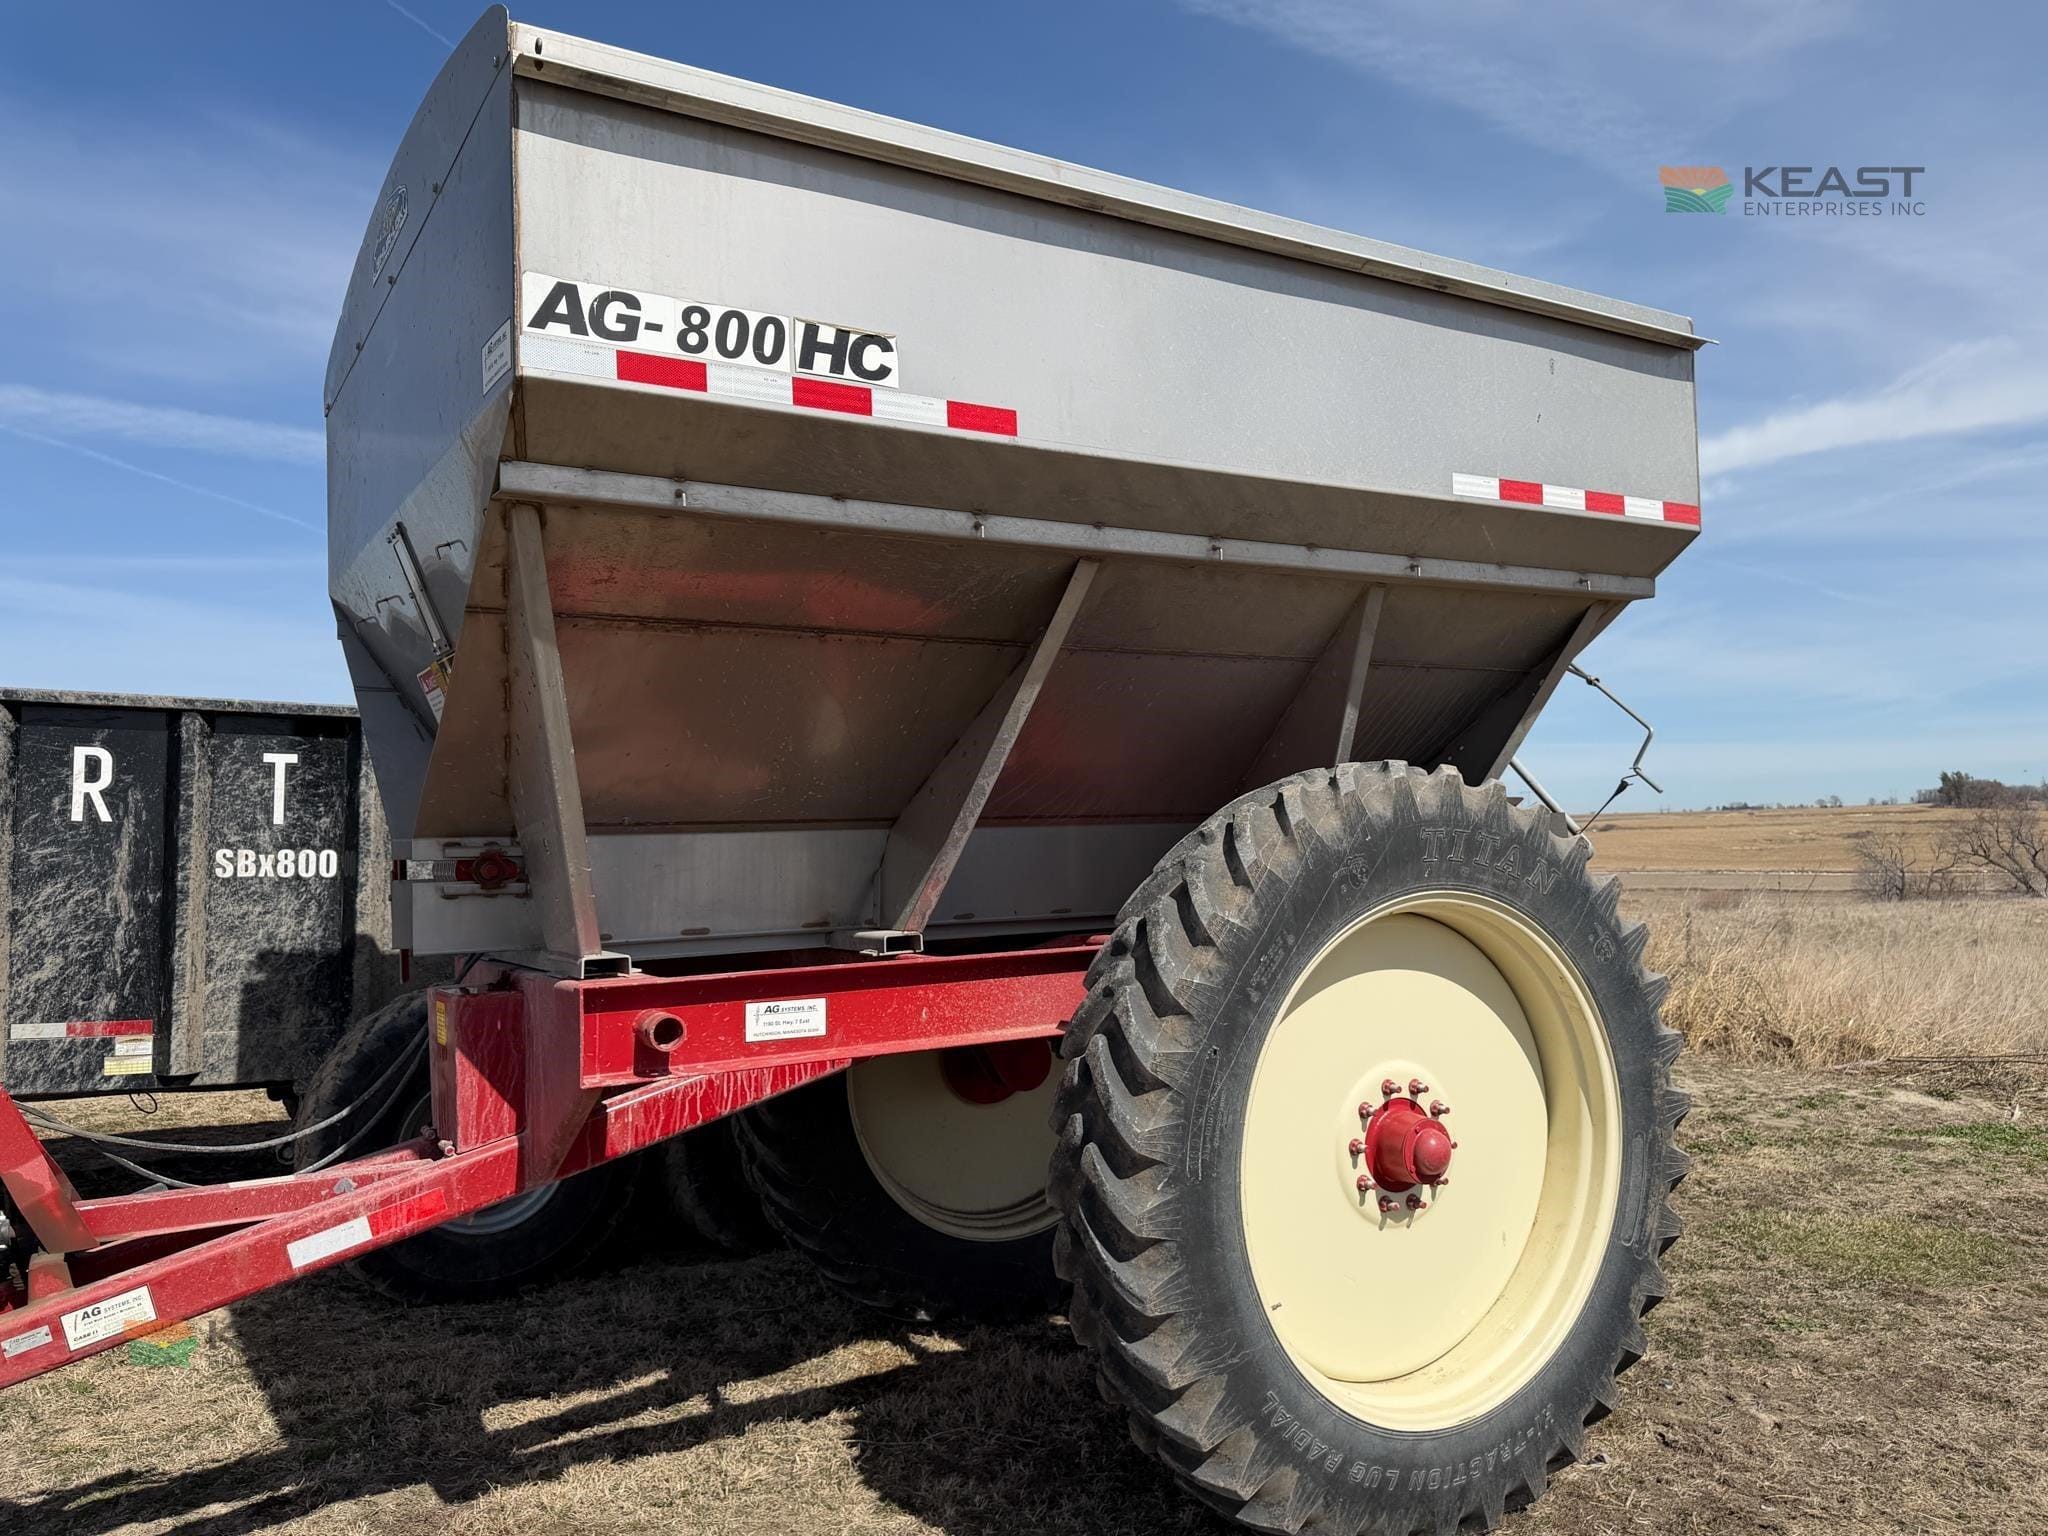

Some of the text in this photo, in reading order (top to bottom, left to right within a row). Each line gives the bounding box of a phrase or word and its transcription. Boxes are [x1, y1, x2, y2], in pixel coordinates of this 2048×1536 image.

[798, 322, 895, 381] HC
[214, 848, 338, 879] SBx800
[1420, 826, 1561, 896] TITAN
[764, 1005, 780, 1014] AG
[82, 1307, 102, 1321] AG
[1262, 1390, 1344, 1473] RADIAL
[1348, 1460, 1400, 1491] LUG
